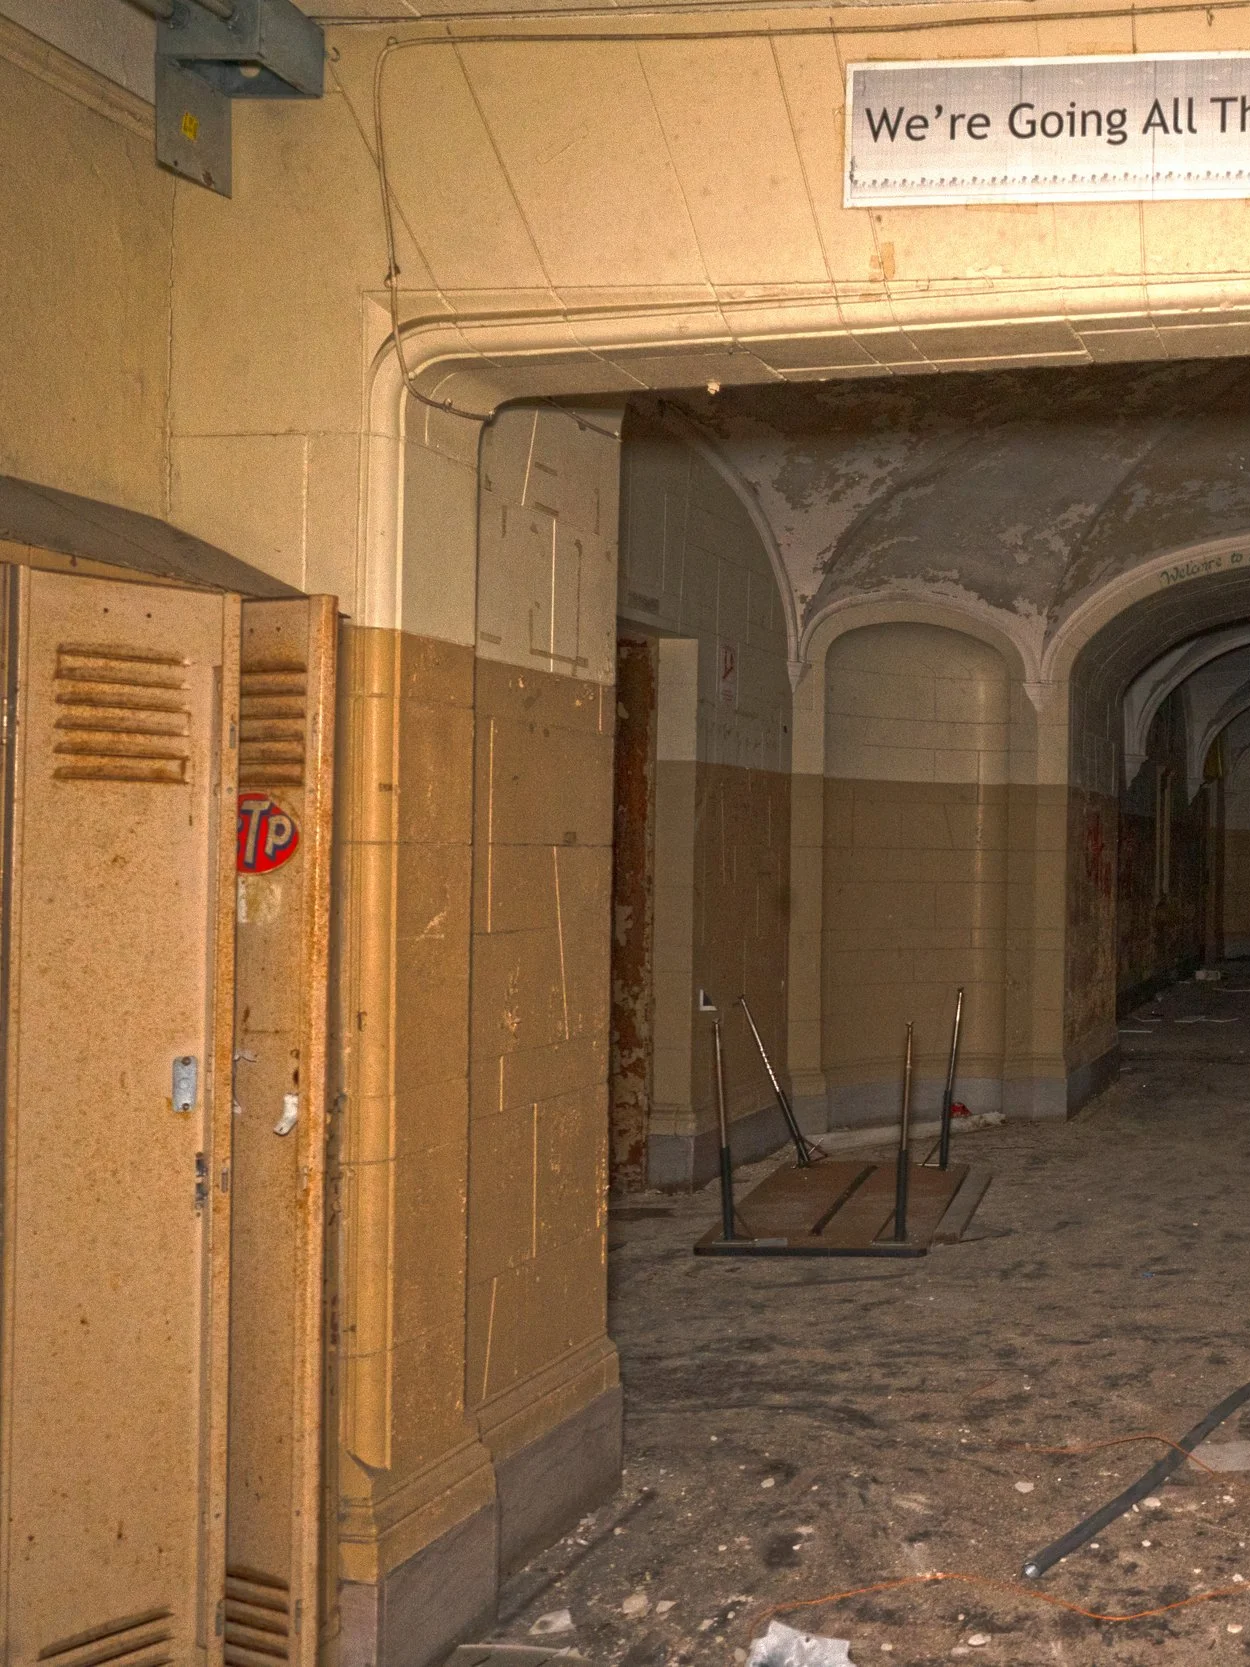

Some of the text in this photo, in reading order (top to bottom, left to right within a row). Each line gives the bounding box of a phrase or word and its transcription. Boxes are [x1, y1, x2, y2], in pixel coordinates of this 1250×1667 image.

[864, 104, 991, 143] We’re
[1007, 102, 1128, 146] Going
[1141, 97, 1198, 135] All
[1160, 556, 1222, 585] Welcome
[1230, 551, 1244, 564] to
[238, 799, 294, 867] TP
